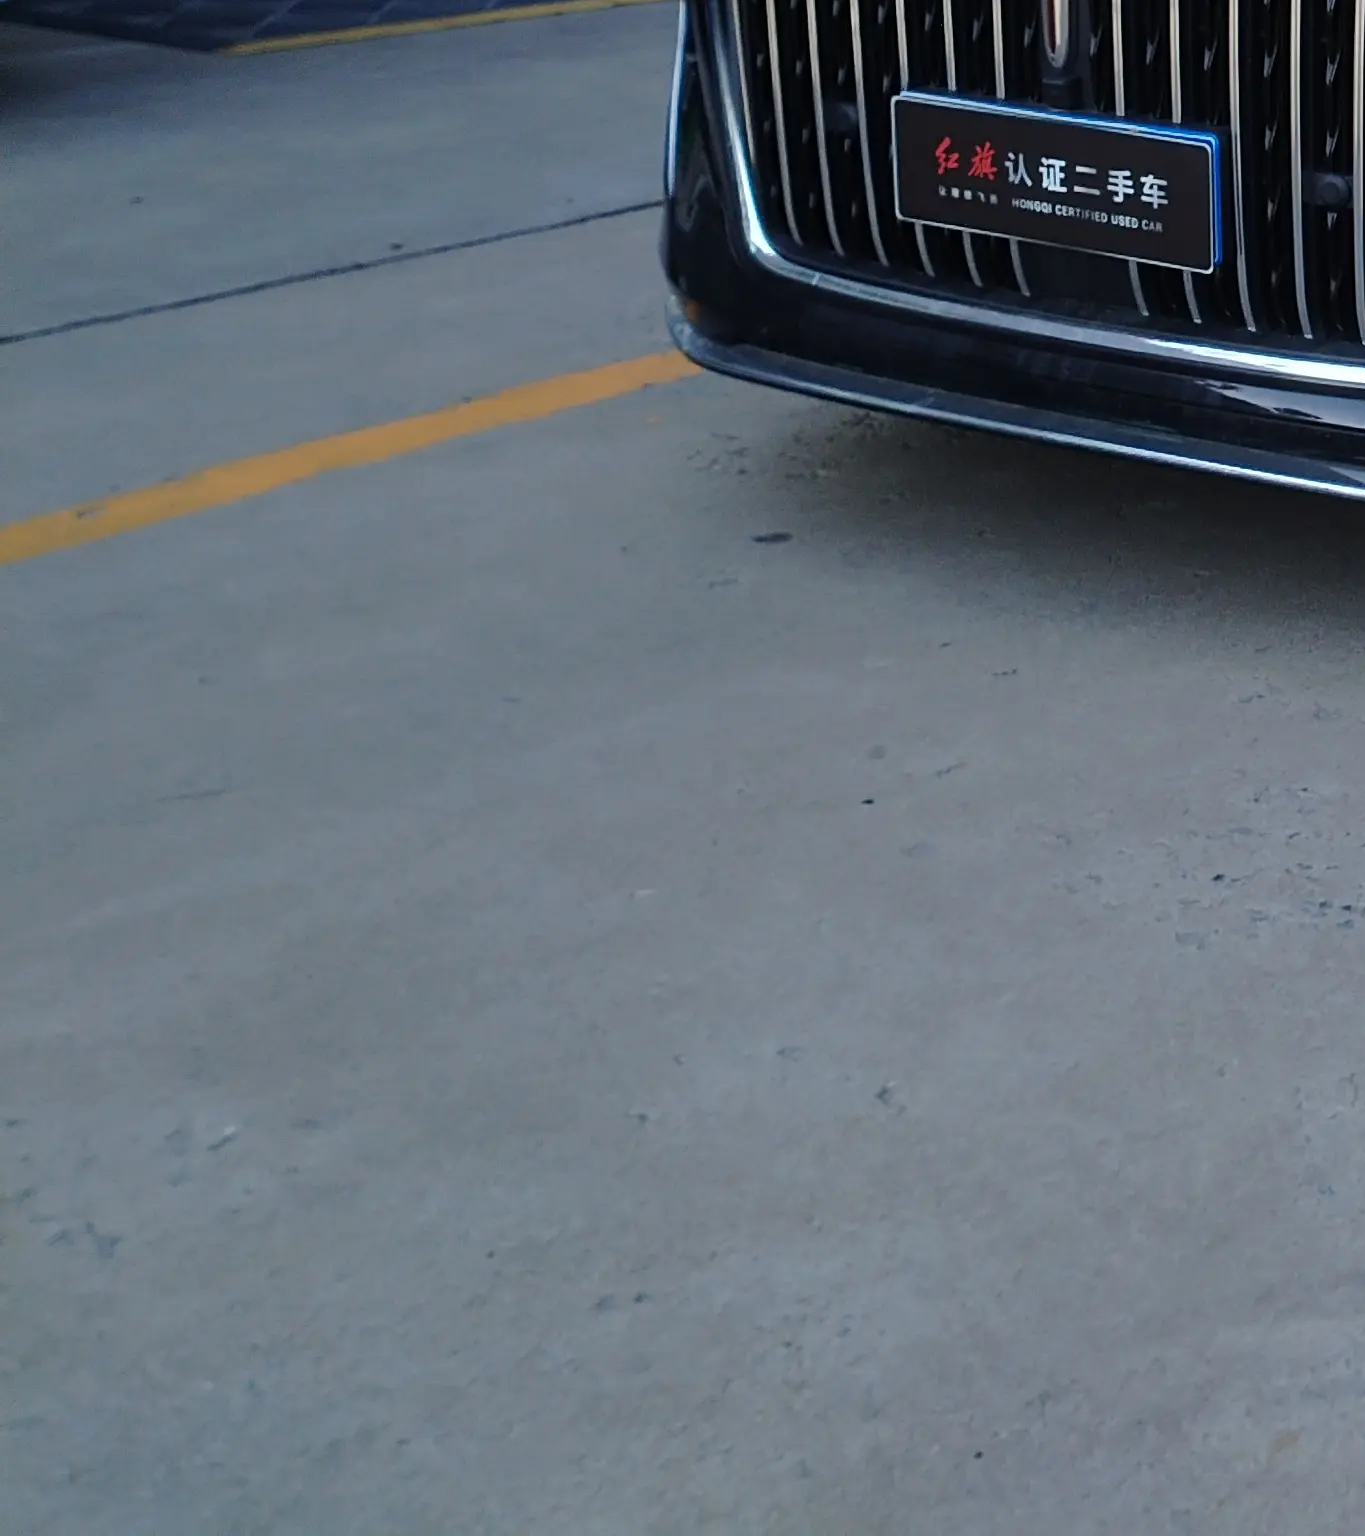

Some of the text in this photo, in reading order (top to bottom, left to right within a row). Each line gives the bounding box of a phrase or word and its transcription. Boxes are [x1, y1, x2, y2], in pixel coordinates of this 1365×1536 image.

[1011, 197, 1163, 233] HONGQI CERTIFIED USED CAR
